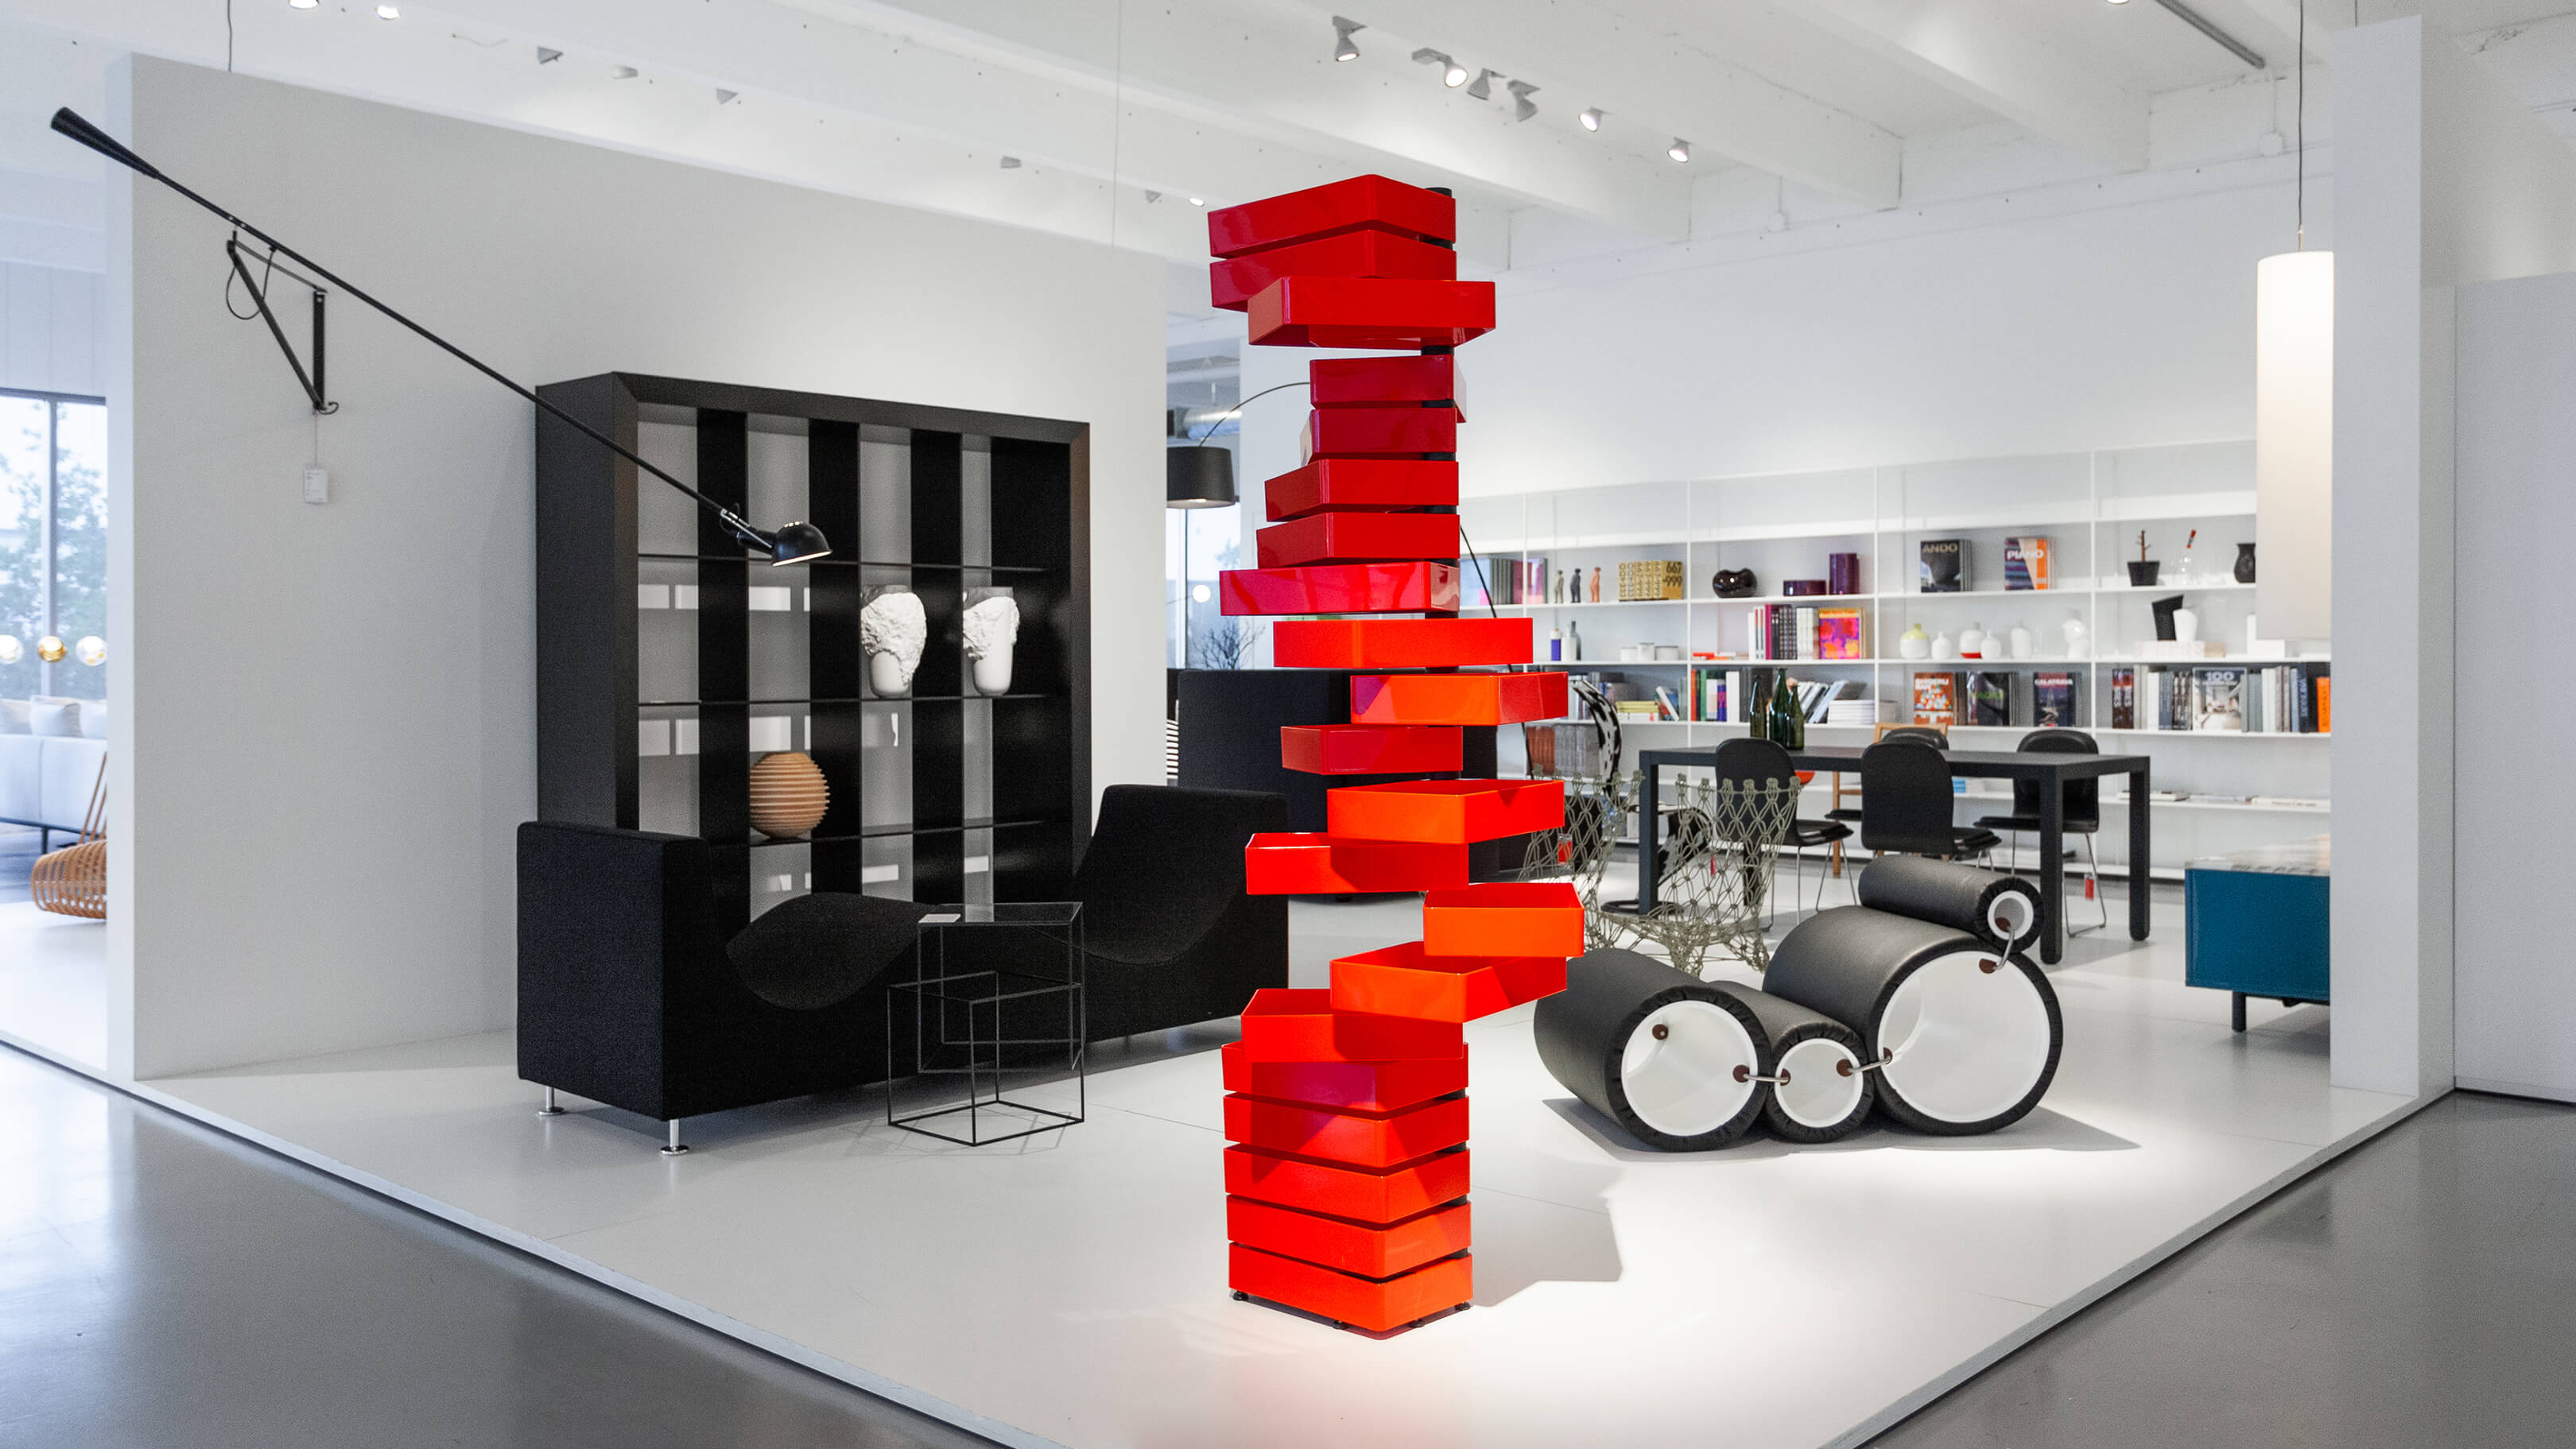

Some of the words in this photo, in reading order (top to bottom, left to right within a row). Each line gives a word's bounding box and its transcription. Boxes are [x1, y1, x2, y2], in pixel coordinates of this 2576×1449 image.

[1922, 544, 1957, 553] ANDO
[2007, 548, 2044, 560] PIANO
[1666, 561, 1682, 573] 667
[2205, 671, 2235, 682] 100
